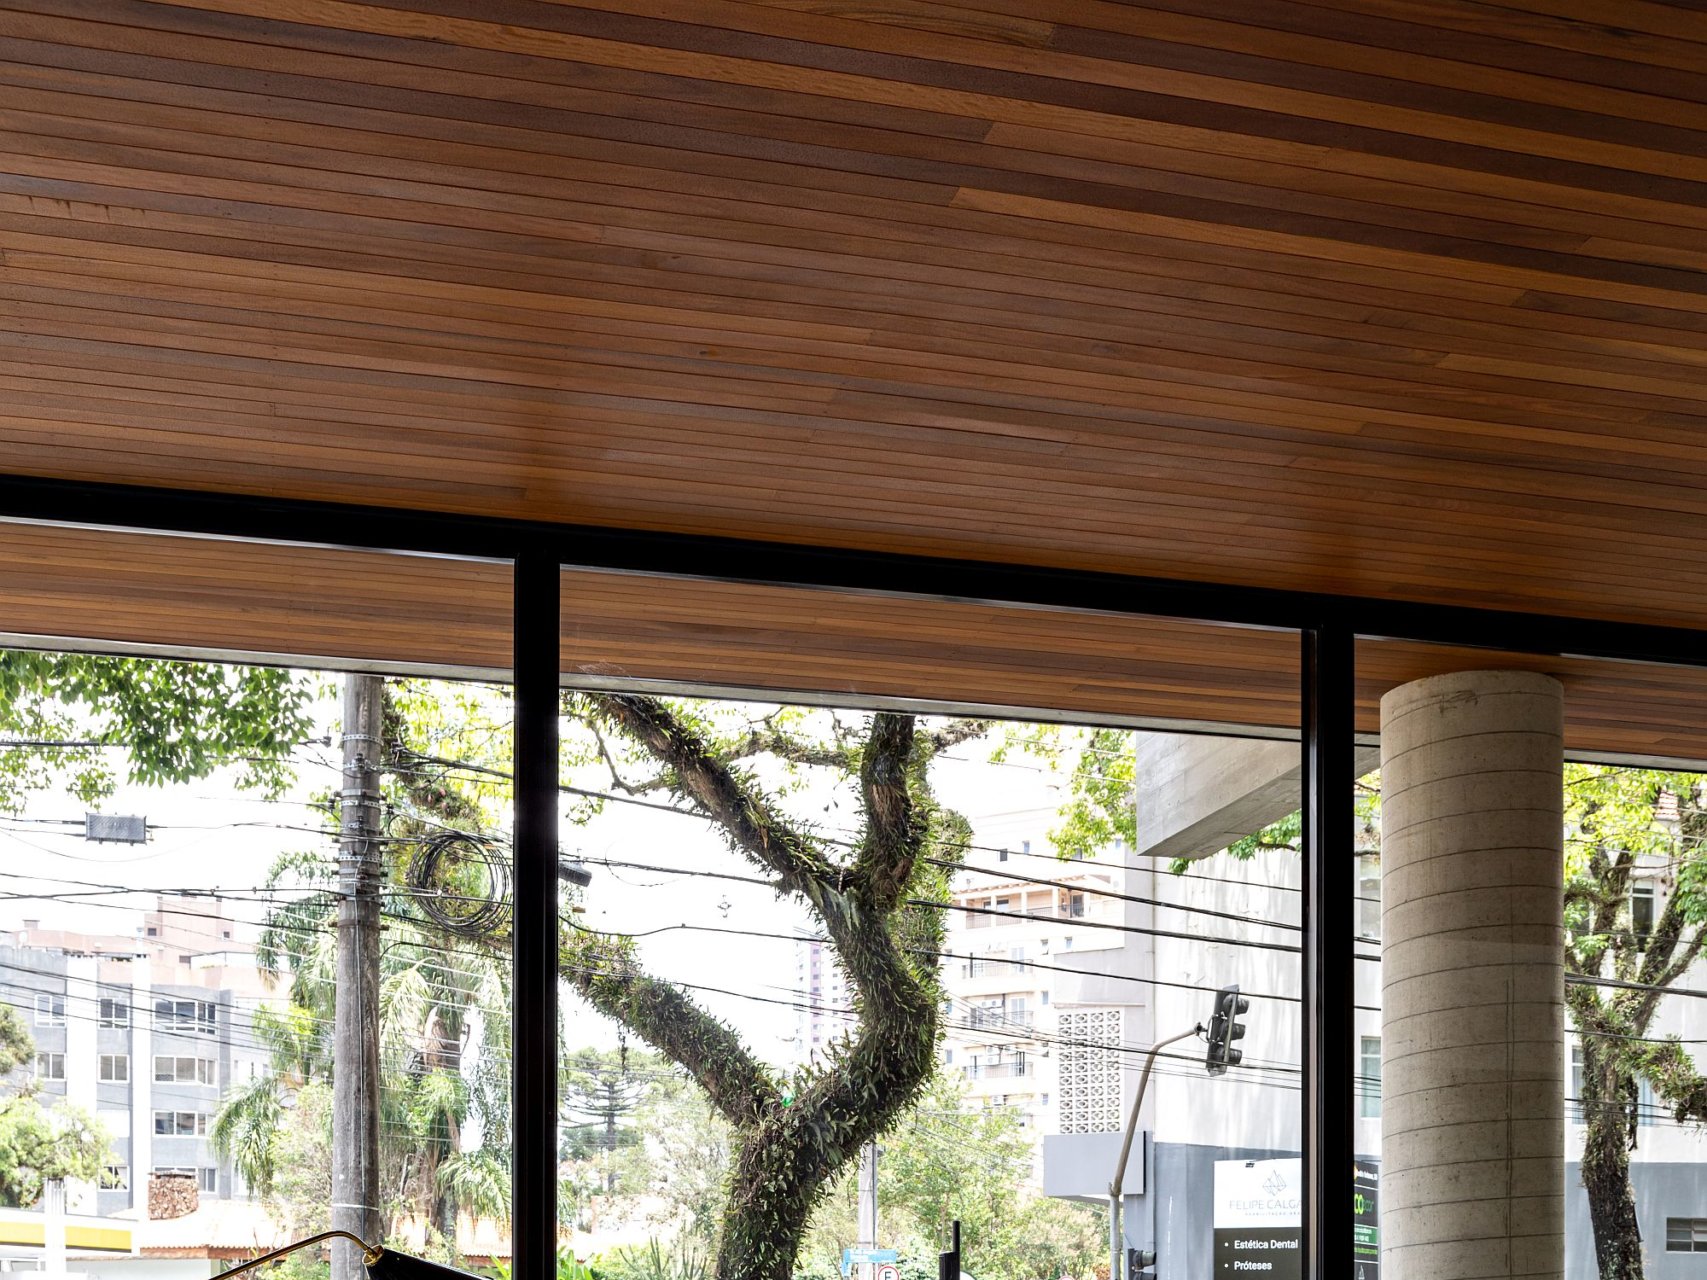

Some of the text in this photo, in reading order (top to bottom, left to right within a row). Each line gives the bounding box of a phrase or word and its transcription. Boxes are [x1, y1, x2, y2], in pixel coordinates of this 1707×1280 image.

[1229, 1199, 1264, 1210] FELIPE
[1234, 1239, 1299, 1249] Estética Dental
[1234, 1261, 1272, 1270] Próteses
